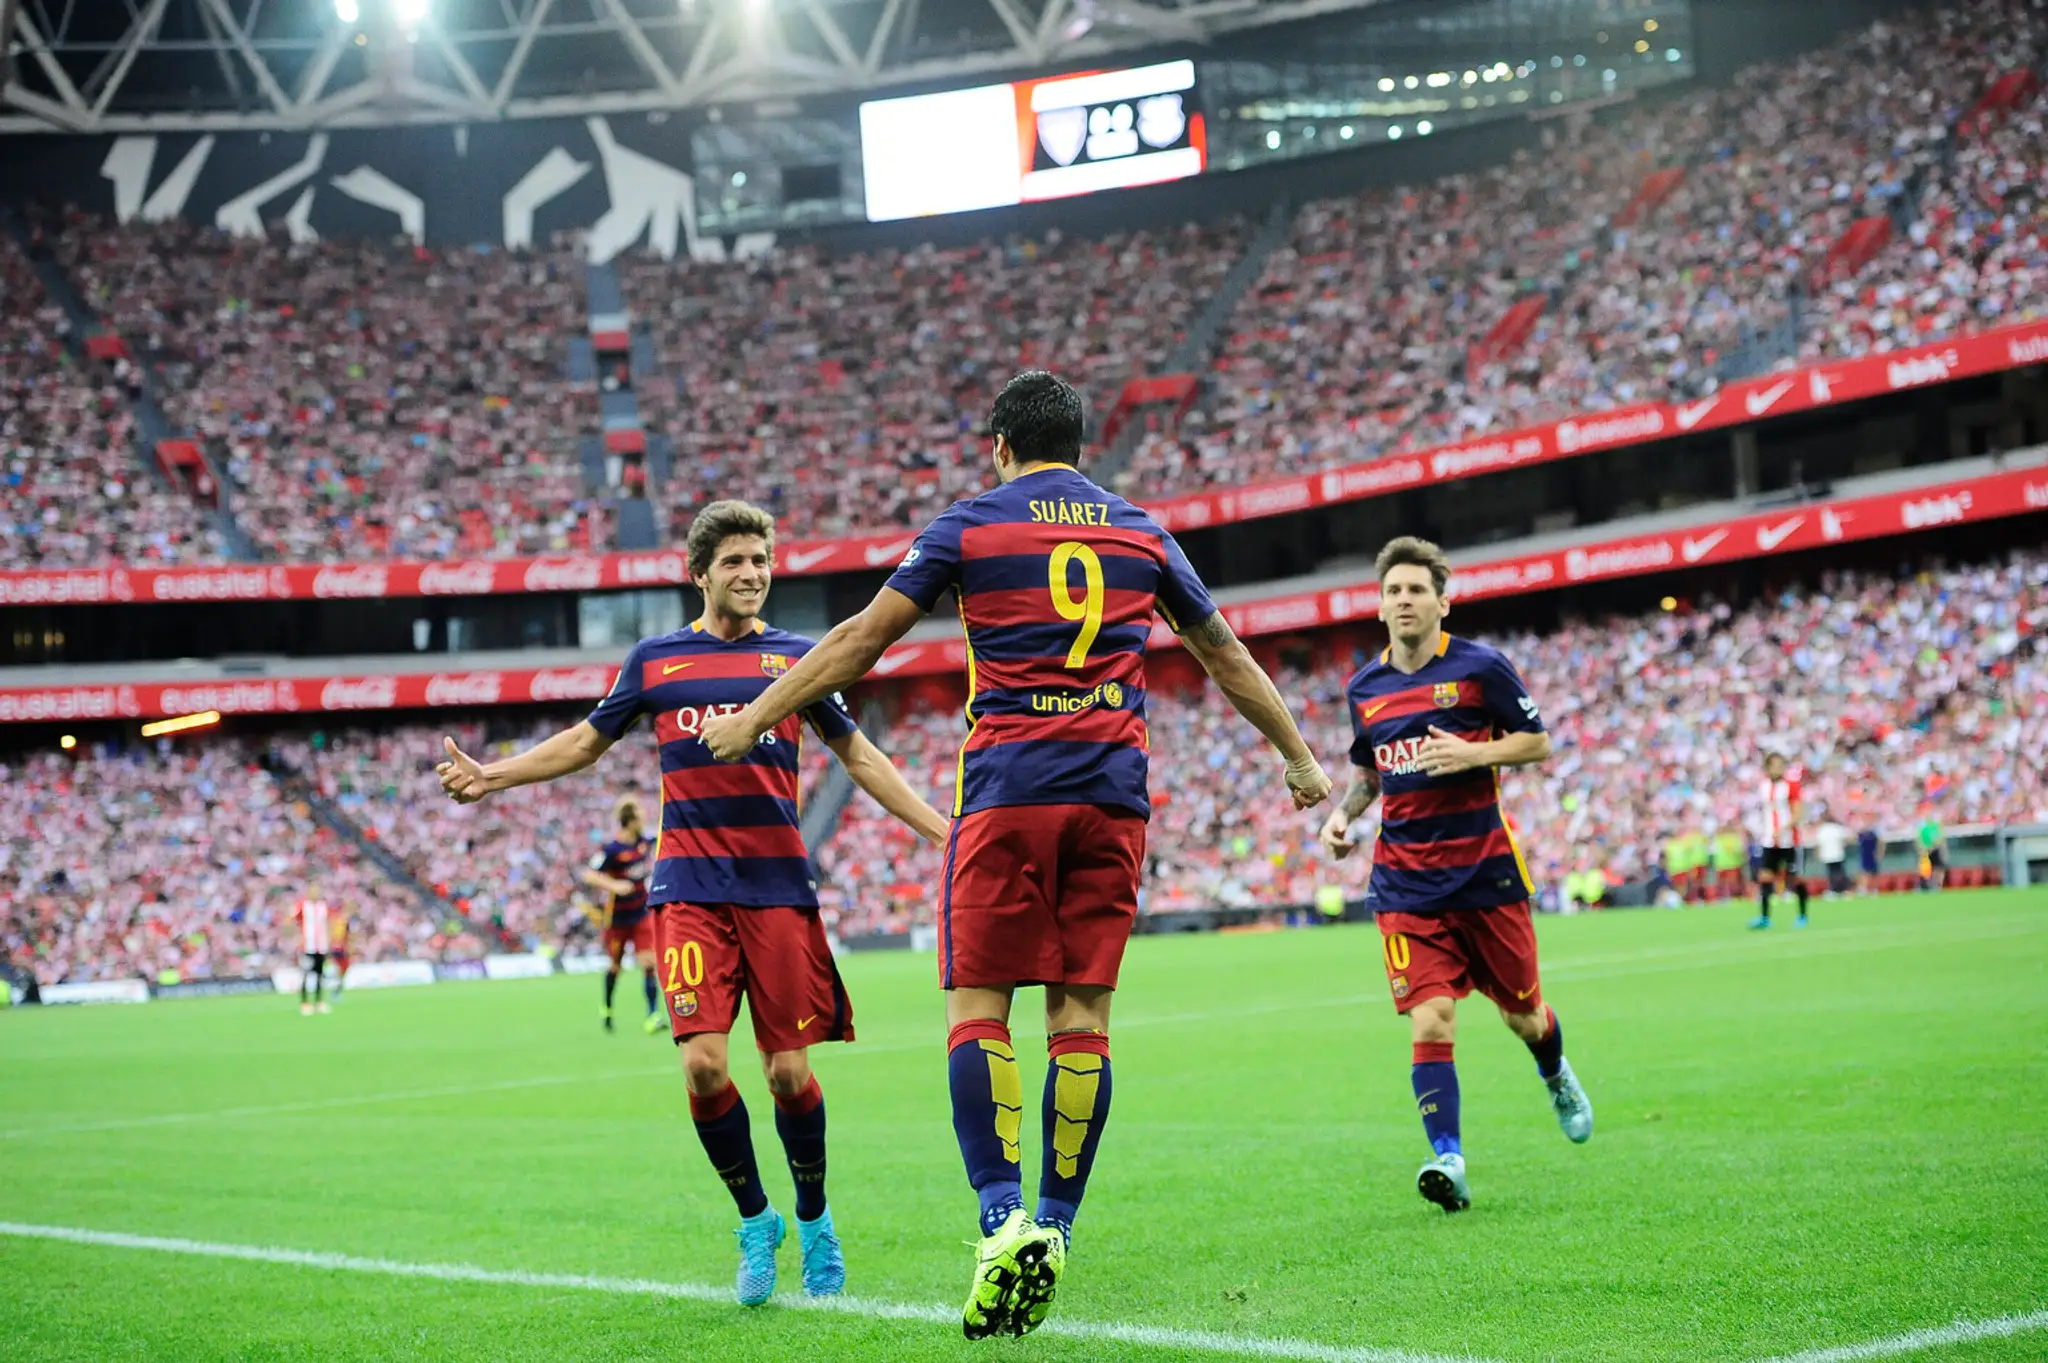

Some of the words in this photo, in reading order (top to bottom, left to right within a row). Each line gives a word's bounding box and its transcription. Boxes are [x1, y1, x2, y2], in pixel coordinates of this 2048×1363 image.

[1029, 498, 1111, 527] SUÁREZ
[153, 570, 268, 599] euskaltel
[1048, 541, 1104, 669] 9
[160, 682, 275, 714] euskaltel
[1032, 684, 1102, 713] unicef
[665, 941, 704, 992] 20
